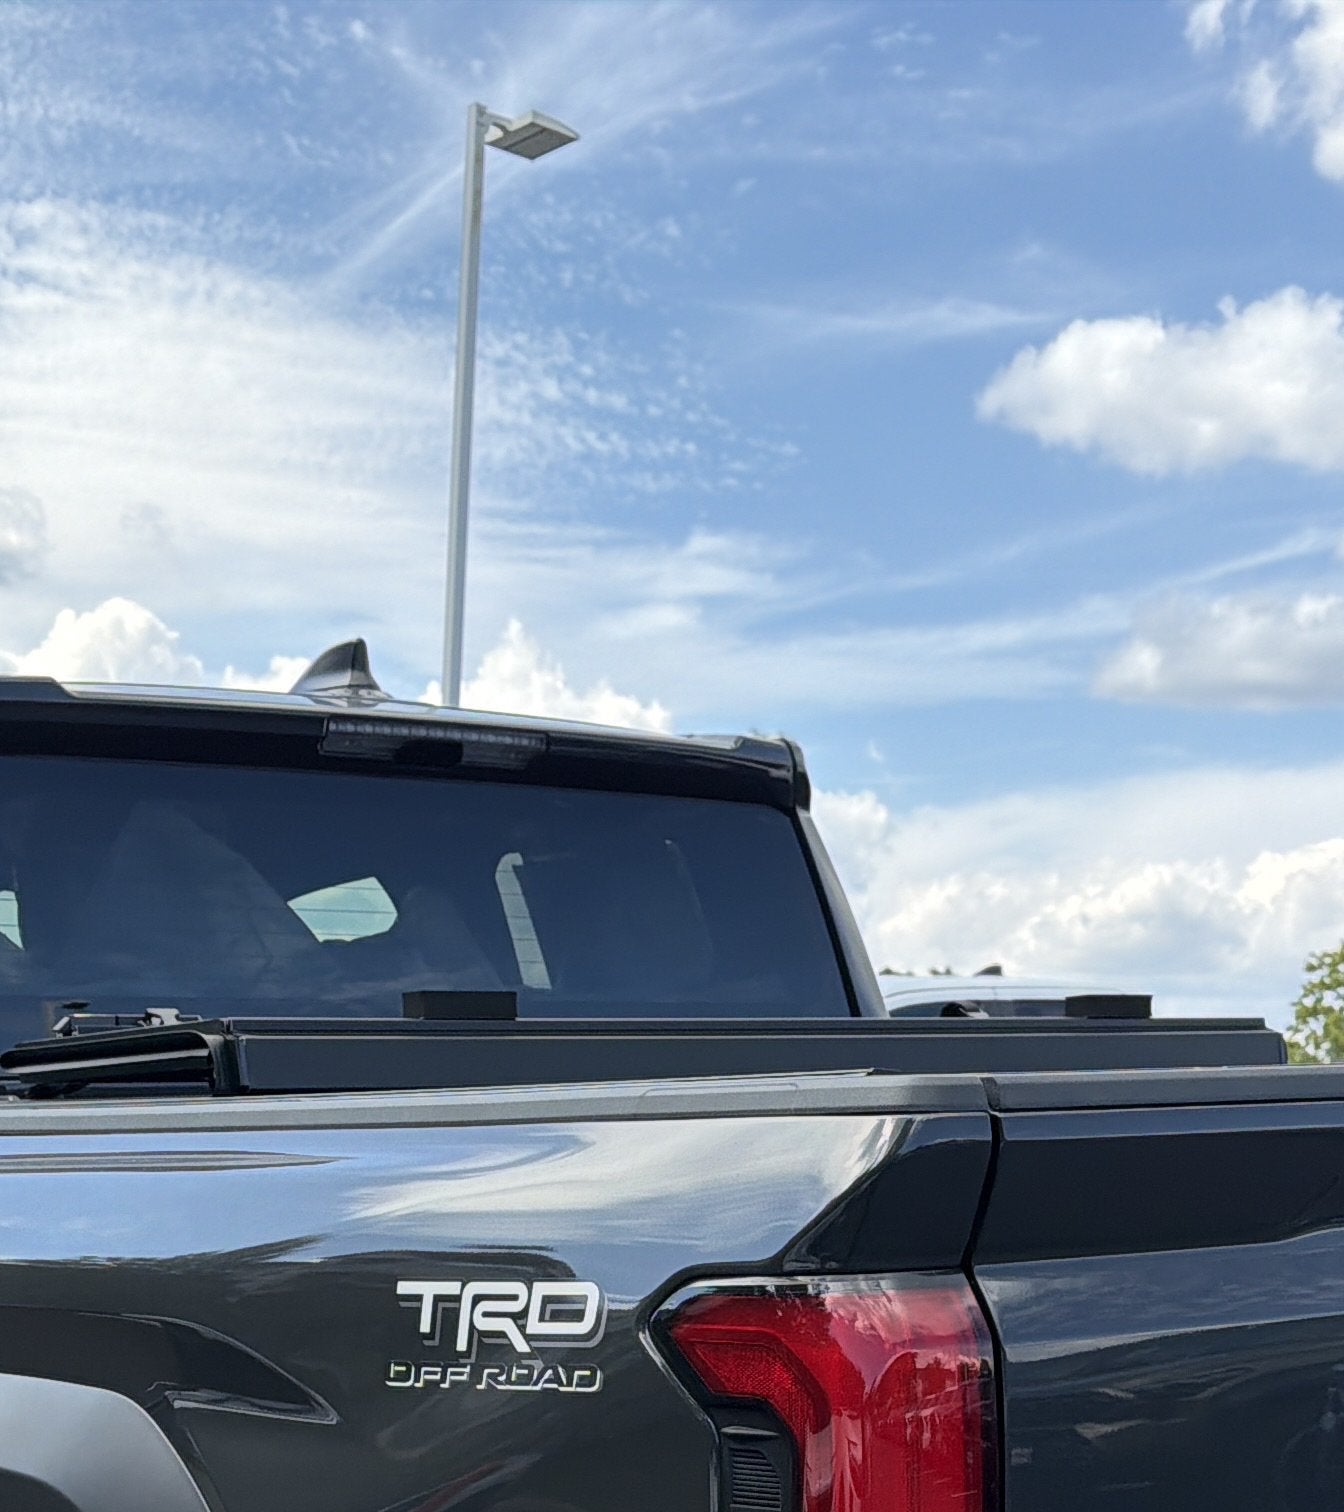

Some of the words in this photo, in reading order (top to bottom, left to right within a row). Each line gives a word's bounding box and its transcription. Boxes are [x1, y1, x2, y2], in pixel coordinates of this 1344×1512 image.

[396, 1280, 603, 1354] TRD
[385, 1360, 471, 1389] OFF
[476, 1360, 604, 1393] ROAD
